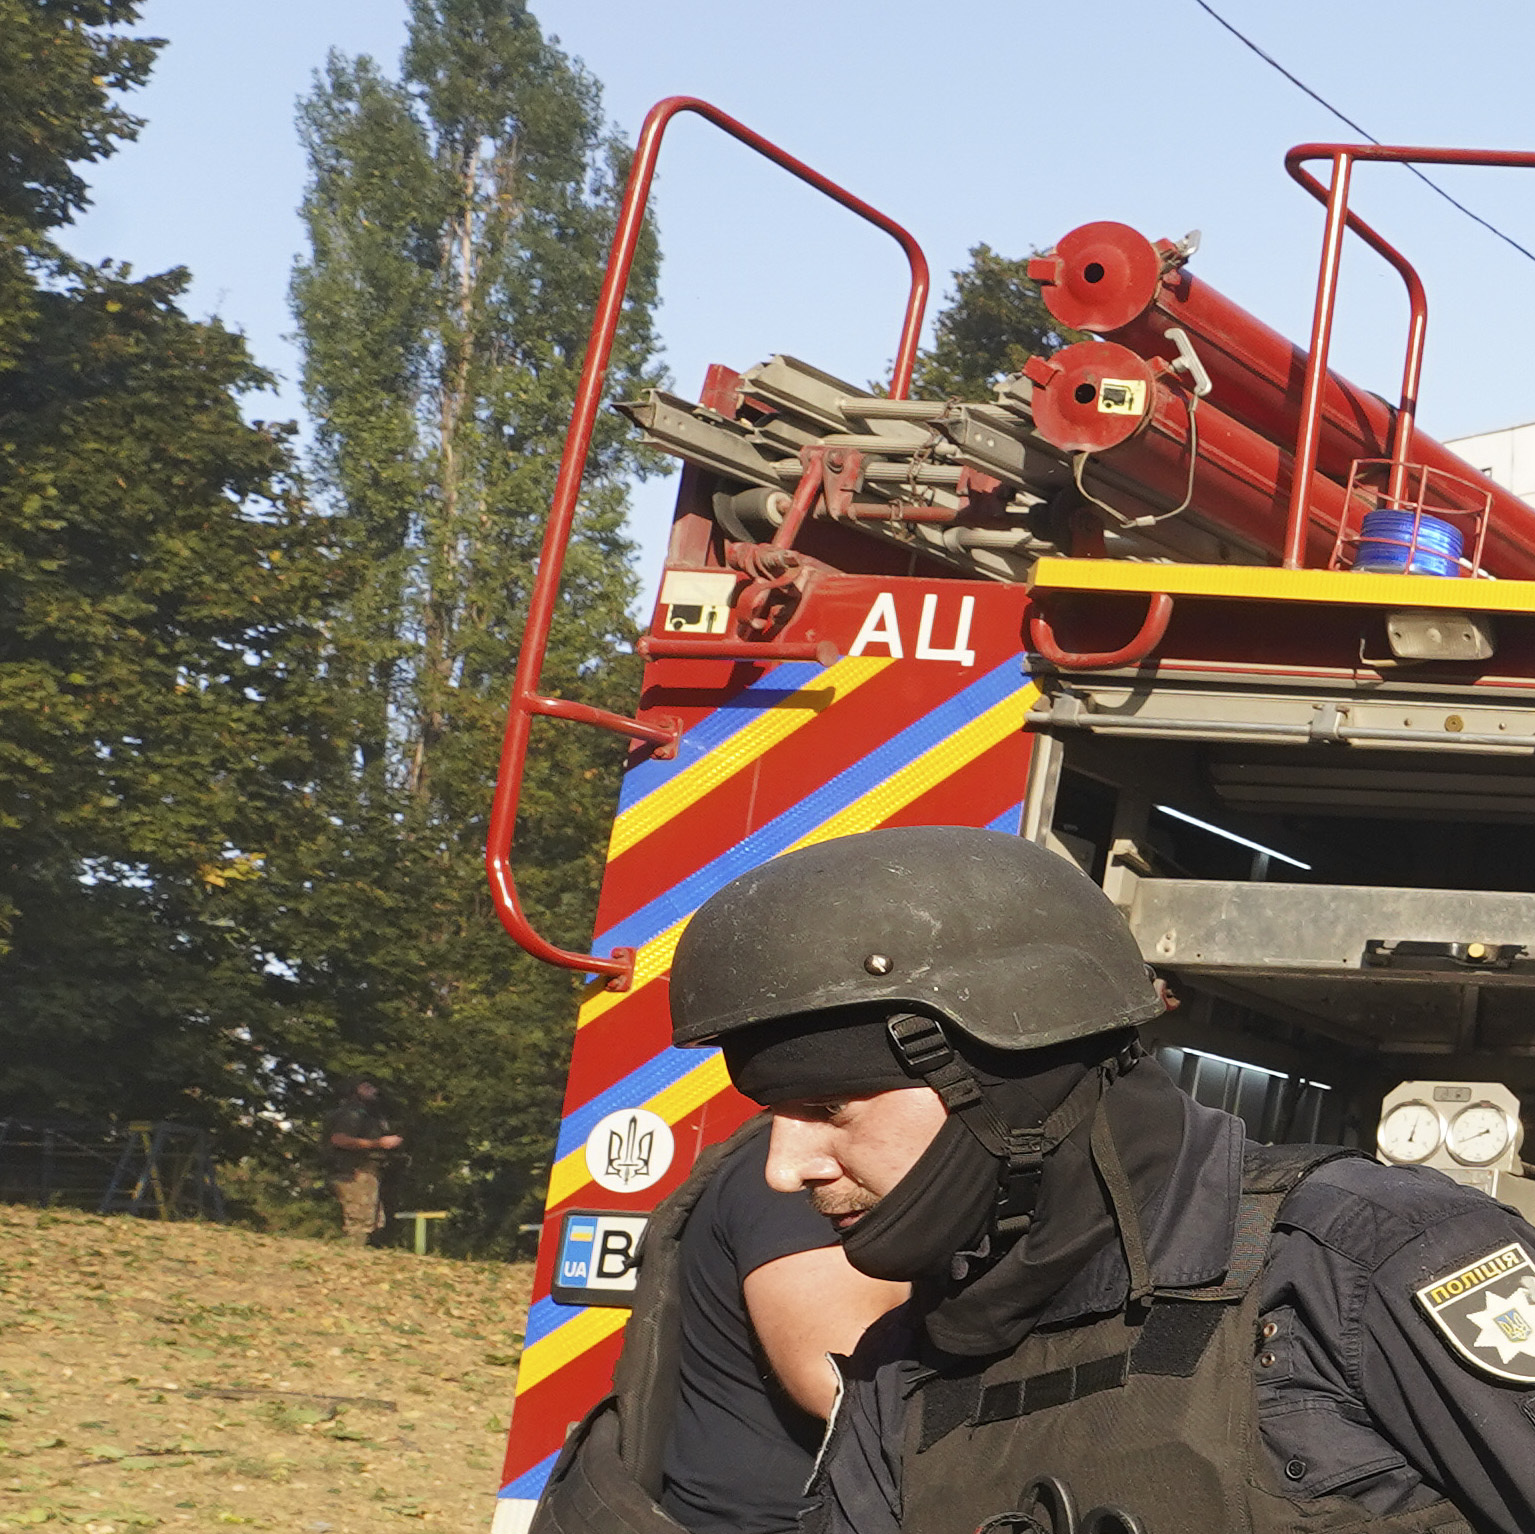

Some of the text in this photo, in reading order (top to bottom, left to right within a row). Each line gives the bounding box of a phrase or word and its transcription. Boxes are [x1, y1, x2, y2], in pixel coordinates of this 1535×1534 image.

[847, 592, 976, 667] АЦ
[564, 1261, 587, 1278] UA
[1430, 1251, 1520, 1304] ПОЛІЦІЯ
